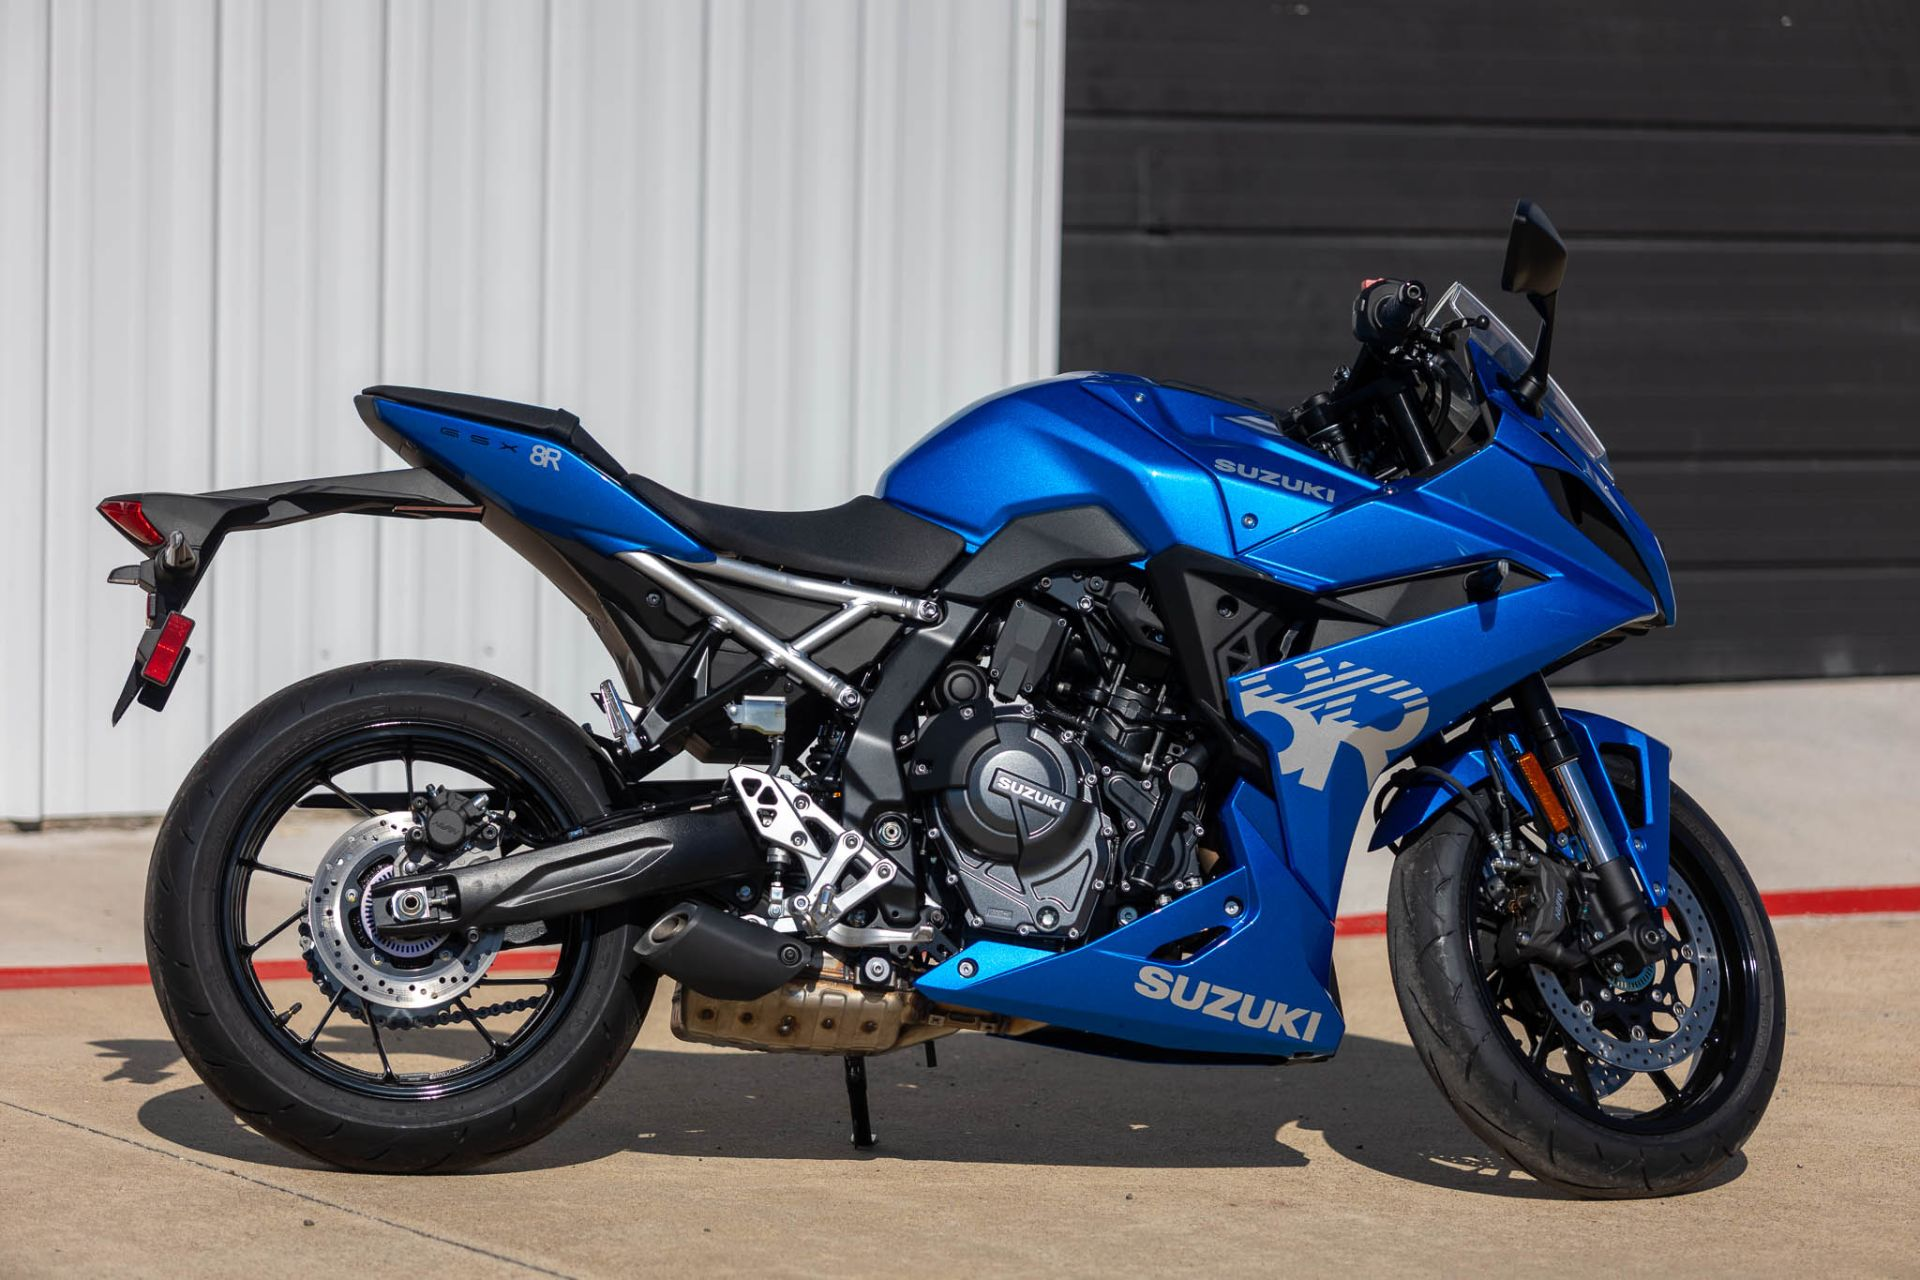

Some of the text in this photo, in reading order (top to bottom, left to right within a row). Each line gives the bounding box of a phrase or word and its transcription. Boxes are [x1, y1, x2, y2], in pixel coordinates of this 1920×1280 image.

[440, 426, 562, 472] GSX 8R
[1214, 458, 1336, 503] SUZUKI
[997, 776, 1066, 813] SUZUKI
[1134, 965, 1323, 1043] SUZUKI
